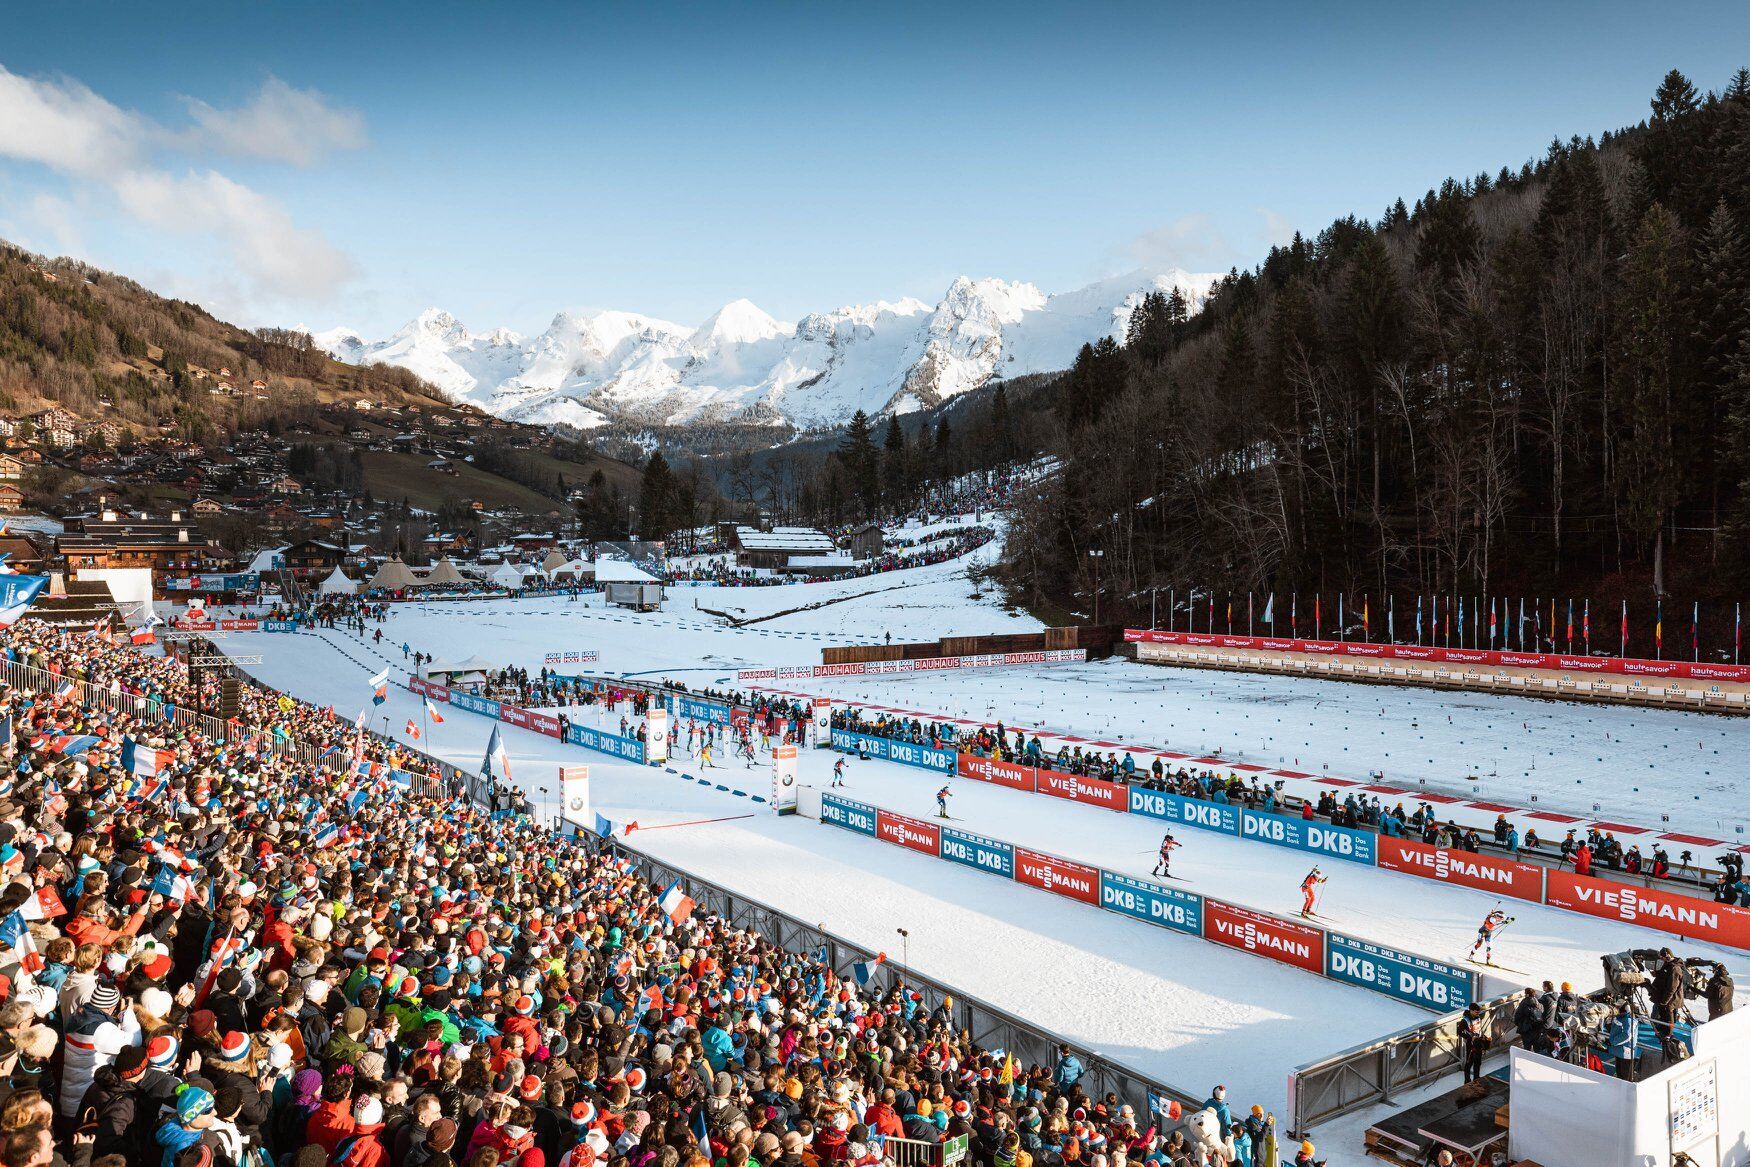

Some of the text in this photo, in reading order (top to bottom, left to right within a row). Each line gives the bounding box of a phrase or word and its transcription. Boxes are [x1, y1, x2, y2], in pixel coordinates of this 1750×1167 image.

[268, 622, 285, 630] DKB
[915, 658, 960, 669] BAUHAUS
[1005, 653, 1045, 664] BAUHAUS
[814, 664, 865, 676] BAUHAUS
[691, 705, 704, 717] DKB
[581, 730, 594, 745] DKB
[601, 737, 615, 752] DKB
[832, 732, 850, 748] DKB
[622, 742, 636, 757] DKB
[891, 745, 912, 761] DKB
[923, 750, 945, 768] DKB
[968, 762, 1022, 781] VIESSMANN
[1049, 778, 1111, 799] VIESSMANN
[822, 804, 840, 820] DKB
[1132, 792, 1165, 815] DKB
[848, 812, 866, 828] DKB
[1184, 802, 1220, 827] DKB
[882, 824, 933, 846] VIESSMANN
[1245, 815, 1284, 840] DKB
[944, 840, 966, 859] DKB
[1308, 827, 1352, 855] DKB
[977, 849, 1002, 870] DKB
[1400, 849, 1512, 884] VIESSMANN
[1022, 864, 1089, 893] VIESSMANN
[1104, 886, 1134, 909] DKB
[1152, 899, 1184, 924] DKB
[1574, 885, 1718, 929] VIESSMANN
[1215, 919, 1309, 958] VIESSMANN
[1332, 935, 1466, 978] DKB DKB DKB DKB DKB DKB DKB DKB
[1332, 951, 1375, 982] DKB
[1378, 965, 1388, 973] Das
[1378, 972, 1392, 980] kann
[1378, 979, 1392, 988] Bank
[1400, 971, 1448, 1004] DKB
[1451, 986, 1462, 995] Das
[1451, 994, 1465, 1003] kann
